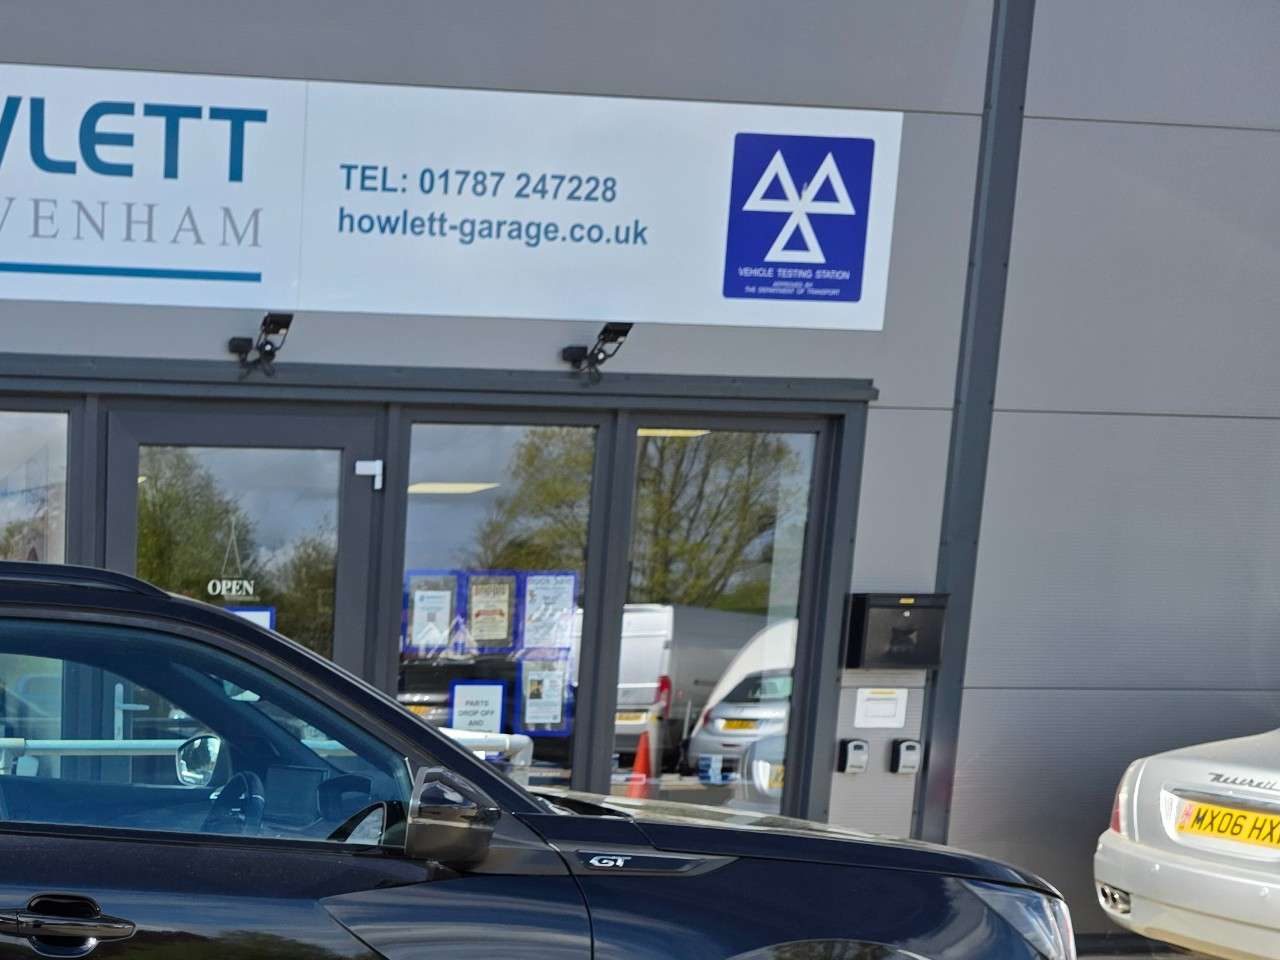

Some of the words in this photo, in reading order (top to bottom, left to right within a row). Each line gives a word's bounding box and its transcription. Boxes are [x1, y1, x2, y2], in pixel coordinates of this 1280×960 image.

[339, 163, 408, 194] TEL:
[418, 167, 506, 198] 01787
[514, 172, 617, 203] 247228
[337, 206, 648, 249] howlett-garage.co.uk
[738, 266, 774, 278] VEHICLE
[777, 268, 813, 279] TESTING
[815, 269, 851, 280] STATION
[207, 579, 255, 595] OPEN
[464, 699, 490, 707] PARTS
[458, 709, 478, 717] DROP
[467, 719, 484, 727] AND
[1190, 807, 1247, 836] MX06
[1247, 816, 1280, 845] HX
[588, 855, 632, 868] GT
